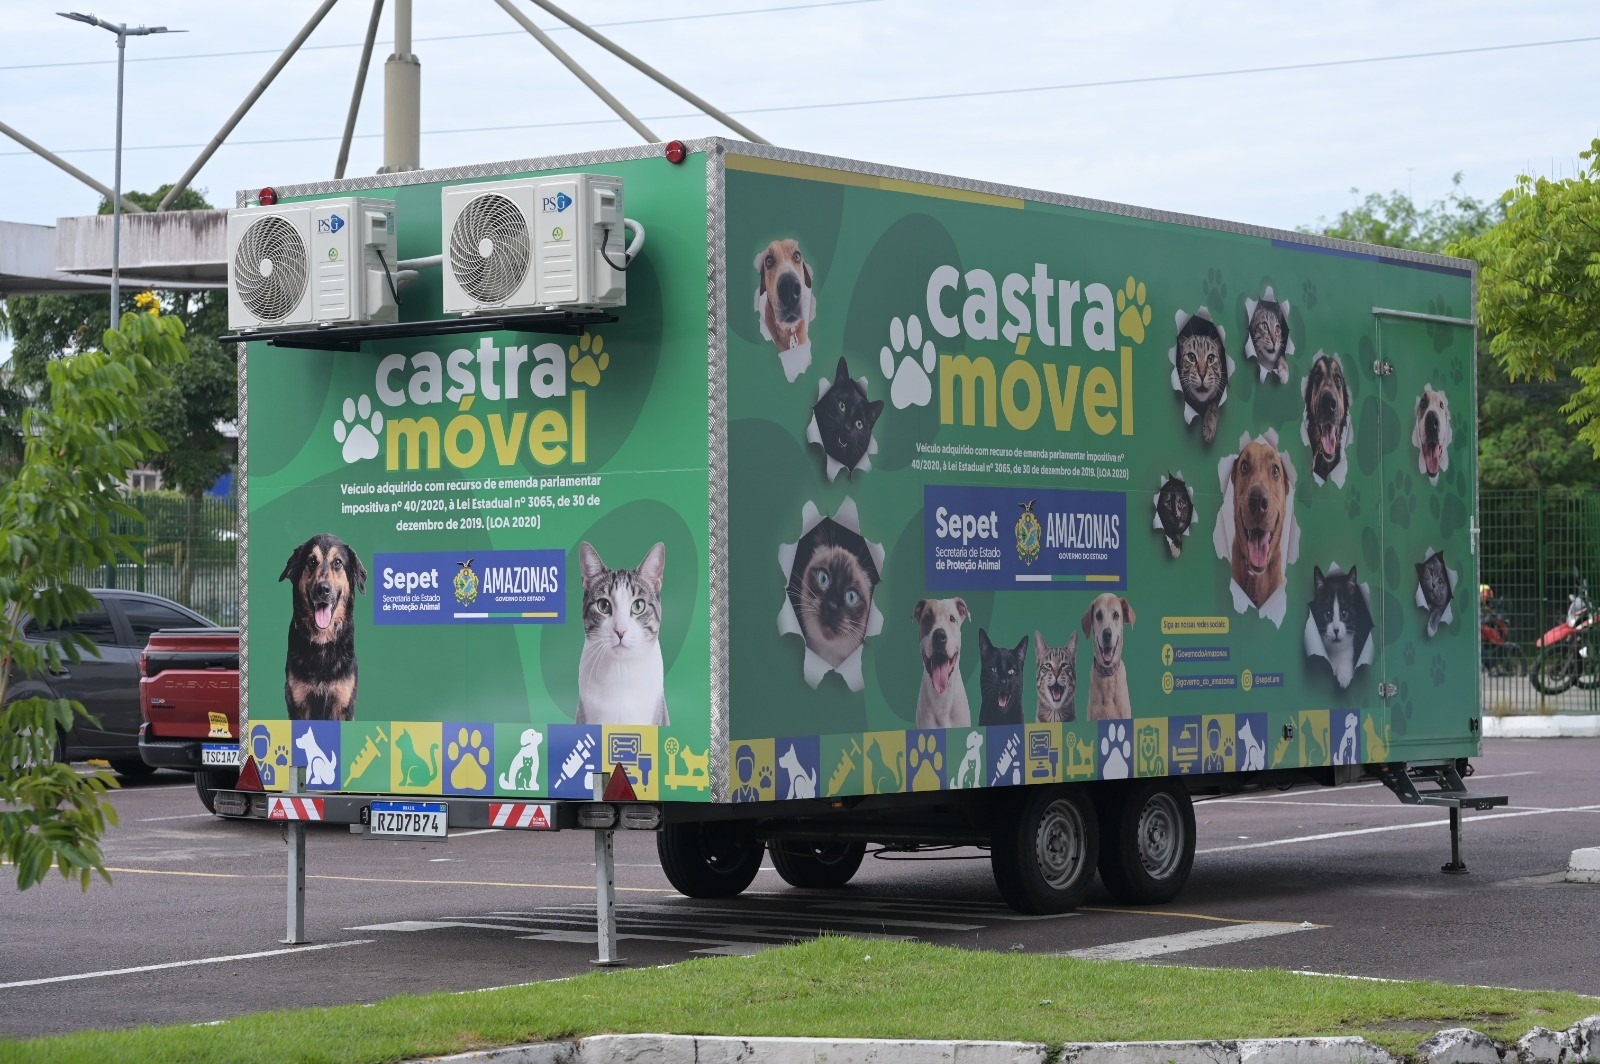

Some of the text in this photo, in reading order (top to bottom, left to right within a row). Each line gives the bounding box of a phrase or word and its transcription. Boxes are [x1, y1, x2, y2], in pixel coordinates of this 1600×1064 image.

[926, 263, 1115, 351] castra
[375, 336, 566, 407] castra
[940, 336, 1133, 435] móvel
[385, 390, 586, 471] móvel
[916, 442, 940, 453] Veículo
[942, 444, 974, 456] adquirido
[975, 447, 989, 456] com
[990, 448, 1013, 457] recurso
[1014, 447, 1022, 458] de
[1024, 449, 1048, 459] emenda
[1049, 450, 1085, 461] parlamentar
[1086, 451, 1116, 463] impositiva
[912, 459, 942, 472] 40/2020,
[948, 461, 958, 471] Lei
[958, 461, 985, 472] Estadual
[995, 463, 1012, 474] 3065,
[1013, 464, 1021, 474] de
[1022, 464, 1030, 474] 30
[1032, 465, 1040, 475] de
[1041, 465, 1072, 476] dezembro
[1072, 466, 1080, 476] de
[1081, 467, 1096, 477] 2019.
[341, 476, 601, 495] Veículo adquirido com recurso de emenda parlamentar
[342, 494, 600, 515] impositiva nº 40/2020, à Lei Estadual nº 3065, de 30 de
[396, 519, 444, 531] dezembro
[446, 518, 458, 530] de
[460, 518, 484, 530] 2019.
[935, 506, 998, 545] Sepet
[1046, 512, 1120, 549] AMAZONAS
[936, 546, 1001, 558] Secretaria de Estado
[1058, 552, 1082, 560] GOVERNO
[1090, 552, 1108, 560] ESTADO
[936, 560, 1000, 573] de Proteção Animal
[383, 567, 439, 594] Sepet
[483, 566, 558, 594] AMAZONAS
[382, 594, 440, 602] Secretaria de Estado
[392, 602, 418, 612] Proteção
[420, 602, 440, 610] Animal
[378, 812, 439, 832] RZD7B74
